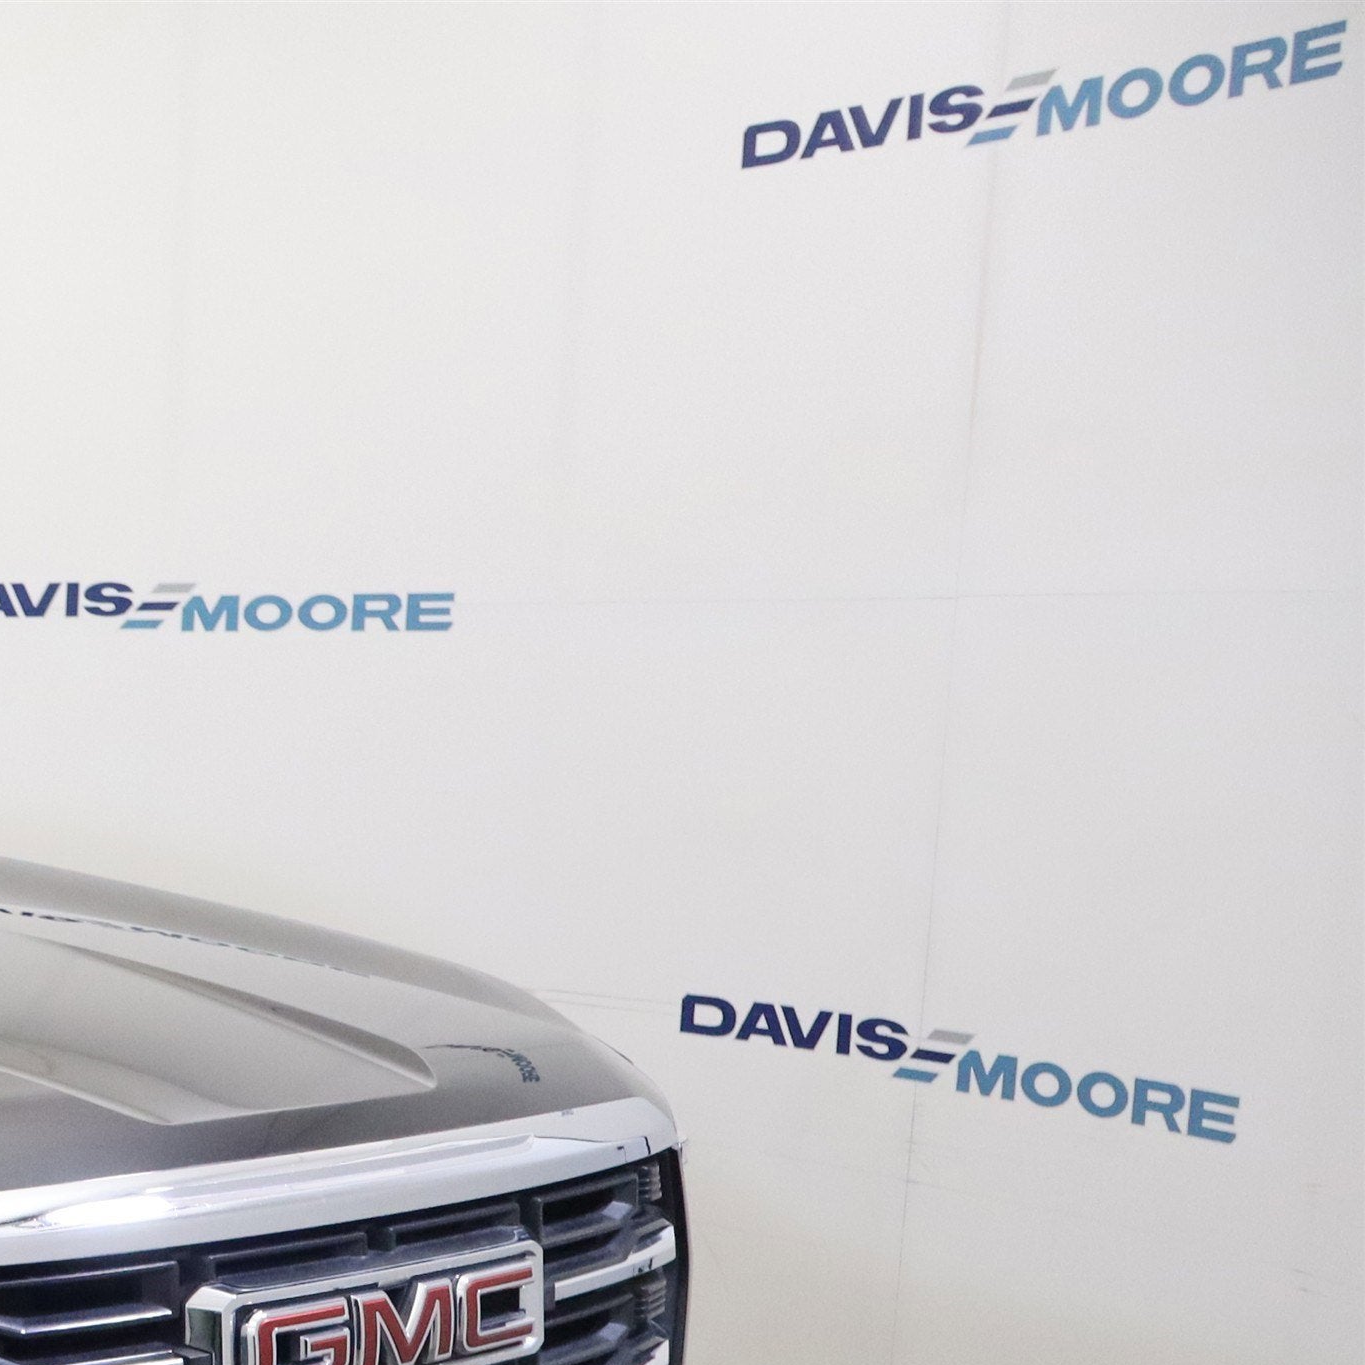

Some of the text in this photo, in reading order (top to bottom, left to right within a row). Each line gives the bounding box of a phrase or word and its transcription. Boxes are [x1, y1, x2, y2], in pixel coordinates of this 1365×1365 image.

[741, 20, 1348, 170] DAVIS MOORE
[180, 592, 456, 633] MOORE
[679, 993, 1241, 1144] DAVIS MOORE
